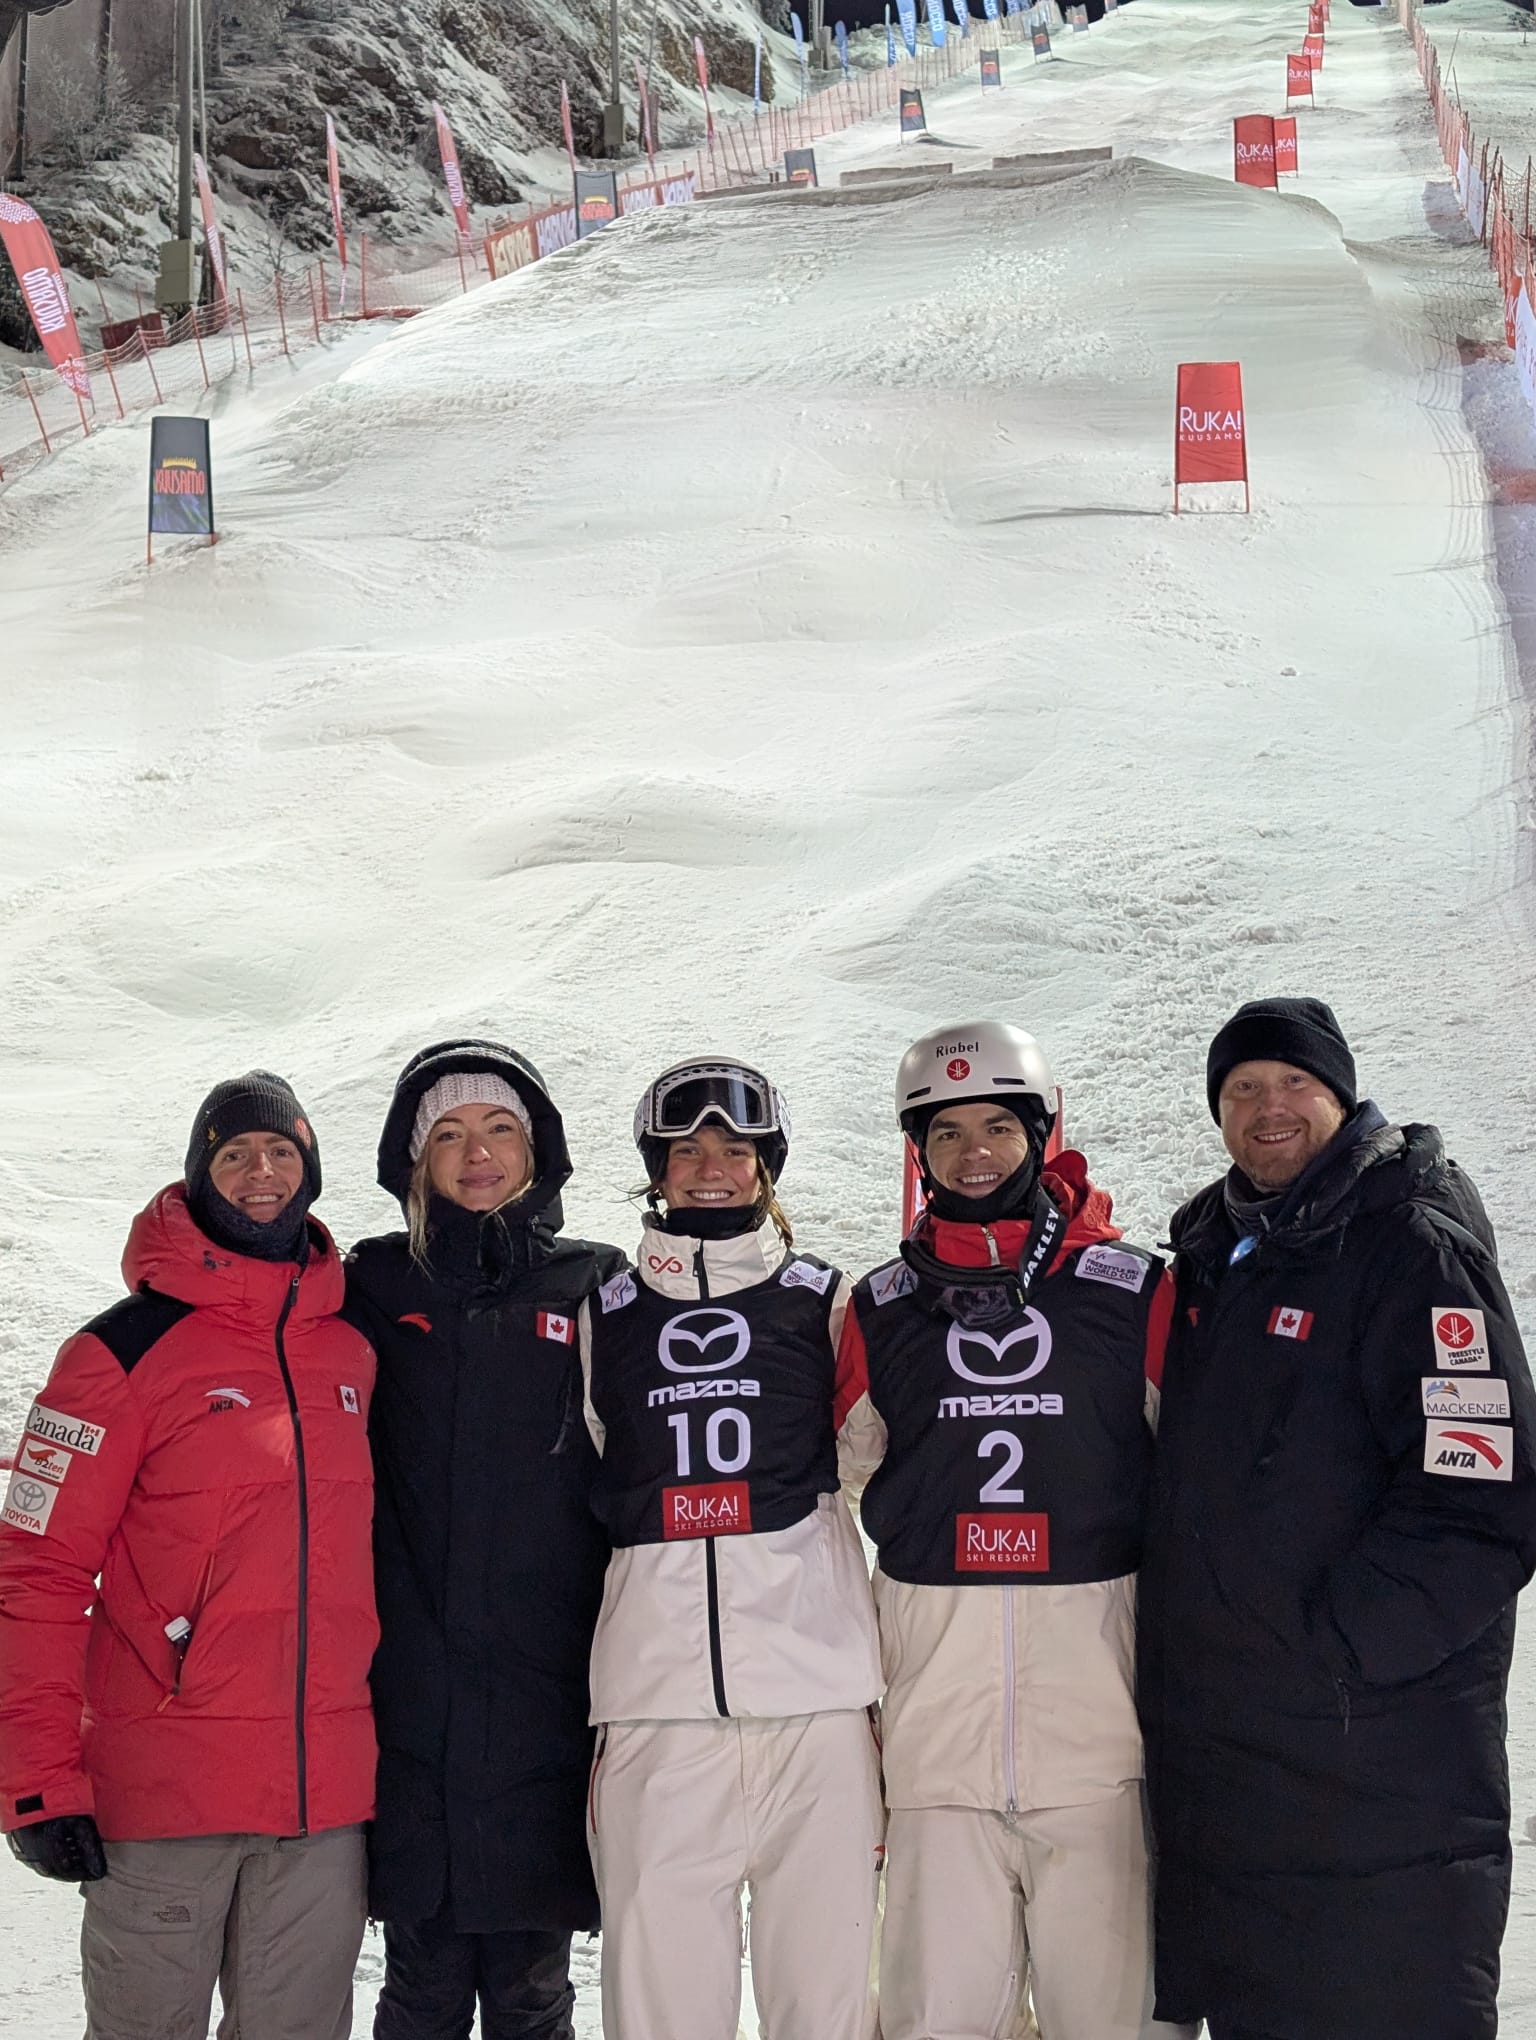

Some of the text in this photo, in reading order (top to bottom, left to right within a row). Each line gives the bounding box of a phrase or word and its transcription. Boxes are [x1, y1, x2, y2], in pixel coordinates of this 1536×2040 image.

[1237, 142, 1274, 159] RUKA!
[22, 266, 67, 335] KUUSAMO
[1180, 406, 1242, 433] RUKA!
[1179, 431, 1242, 442] KUUSAMO
[155, 468, 205, 496] KUUSAMO
[936, 1041, 979, 1059] Riobel
[1023, 1207, 1059, 1289] OAKLEY
[1085, 1263, 1138, 1281] WORLD CUP
[1448, 1347, 1485, 1359] FREESTYLE
[208, 1400, 234, 1414] ANTA
[1426, 1402, 1507, 1415] MACKENZIE
[26, 1405, 95, 1452] Canada
[667, 1407, 752, 1477] 10
[977, 1429, 1025, 1503] 2
[1435, 1449, 1477, 1469] ANTA
[4, 1507, 41, 1531] TOYOTA
[674, 1495, 739, 1522] RUKA!
[674, 1518, 739, 1532] SKI RESORT
[966, 1522, 1037, 1552] RUKA!
[966, 1553, 1037, 1562] SKI RESORT
